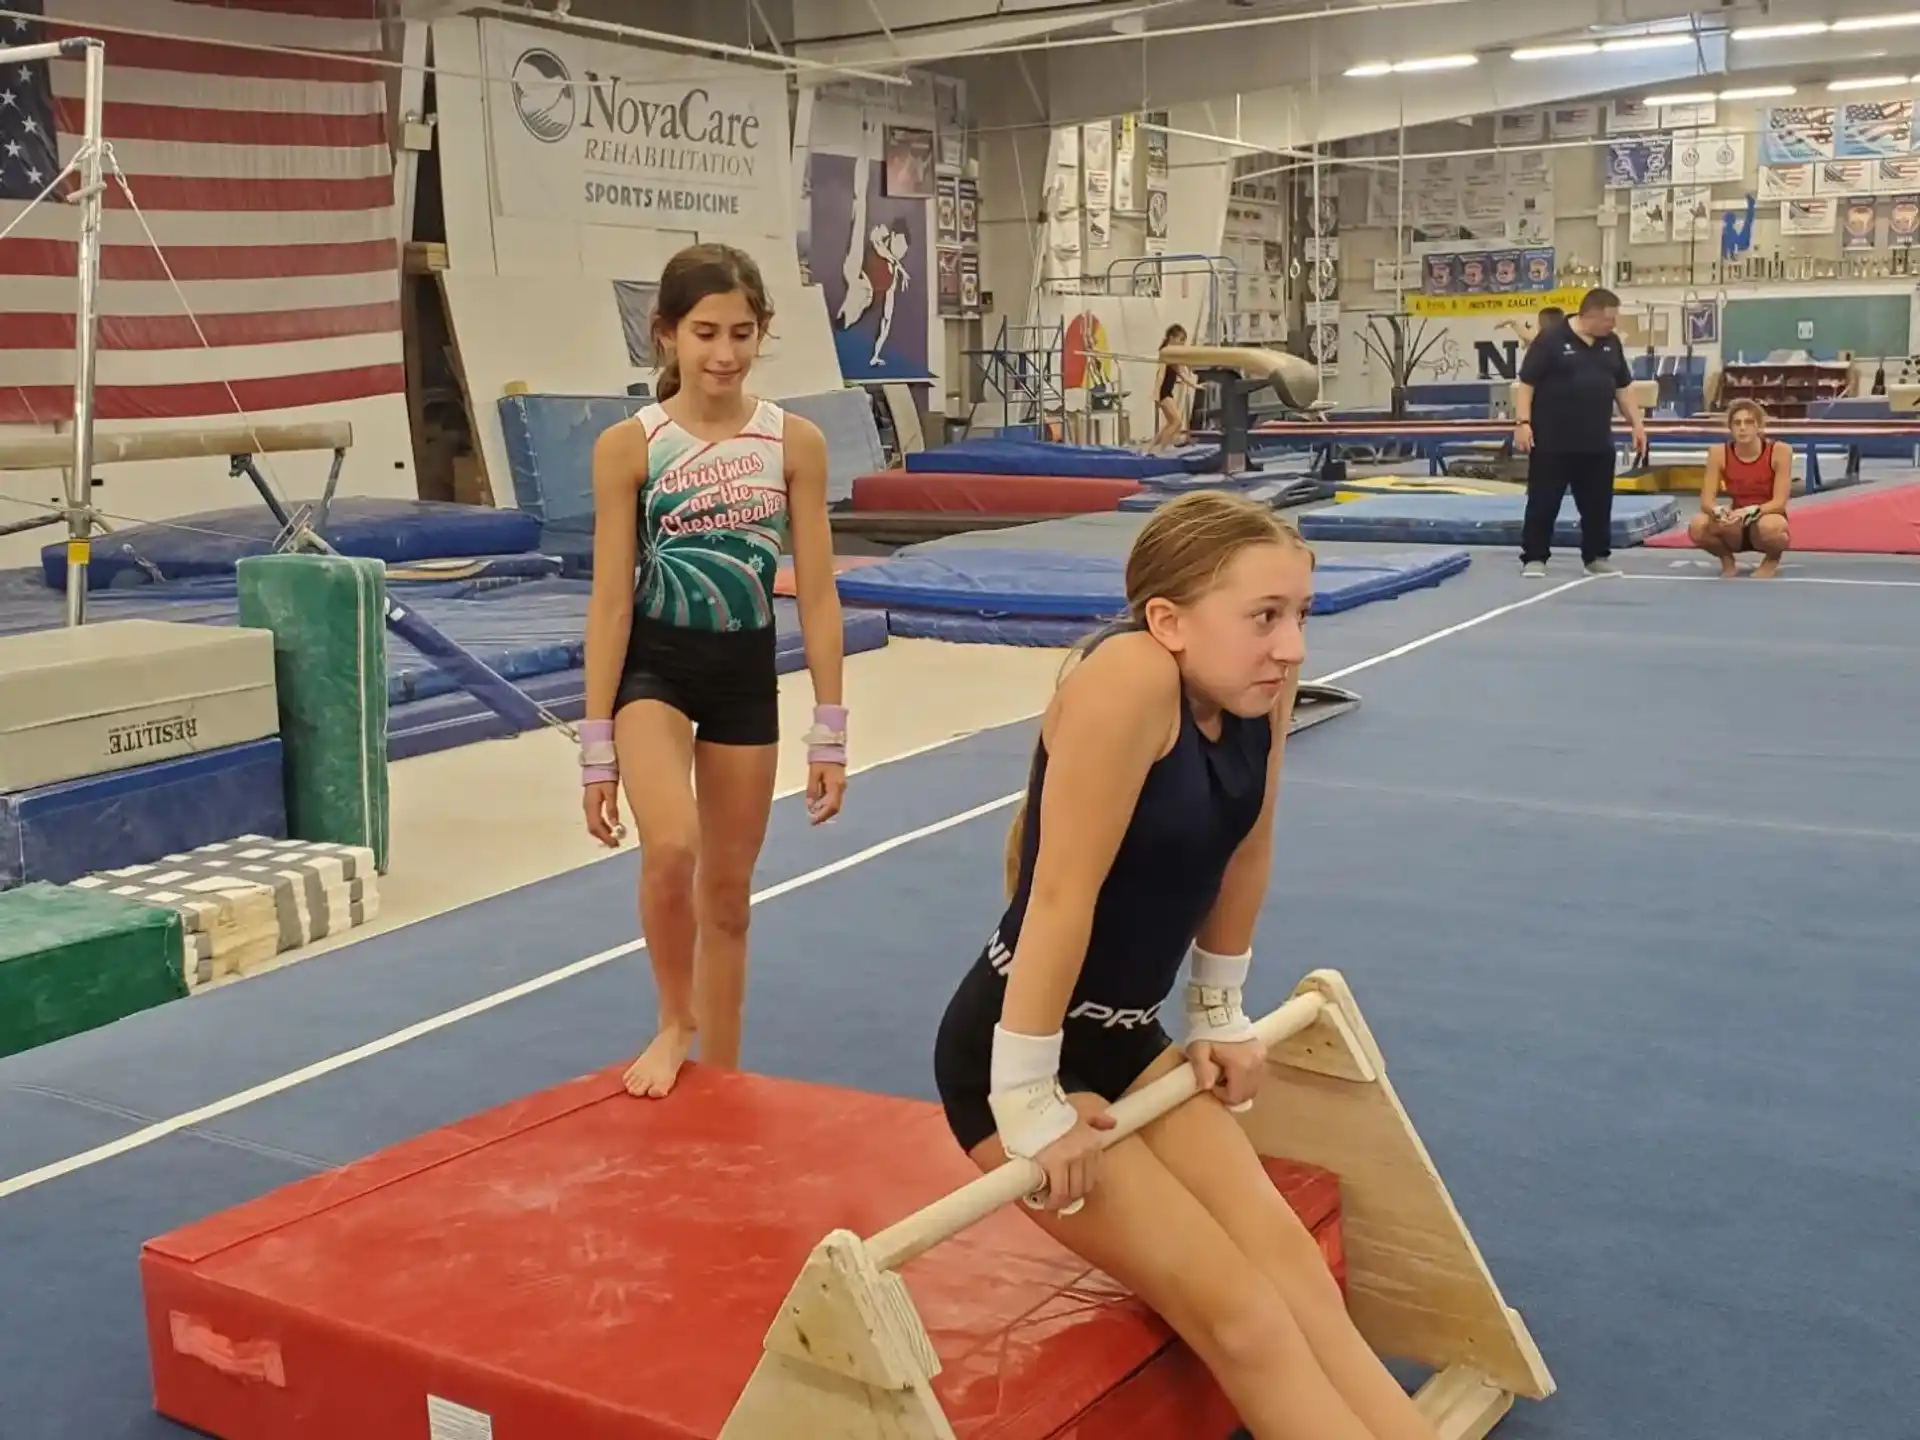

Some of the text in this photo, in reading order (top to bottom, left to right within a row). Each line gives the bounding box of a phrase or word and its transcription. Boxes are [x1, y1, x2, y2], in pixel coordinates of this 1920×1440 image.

[580, 70, 760, 149] NovaCare
[584, 139, 755, 176] REHABILITATION
[584, 181, 740, 214] SPORTS MEDICINE
[661, 452, 764, 494] Christmas
[660, 491, 784, 536] Chesapeake
[689, 482, 754, 513] on the
[108, 718, 199, 755] RESILITE
